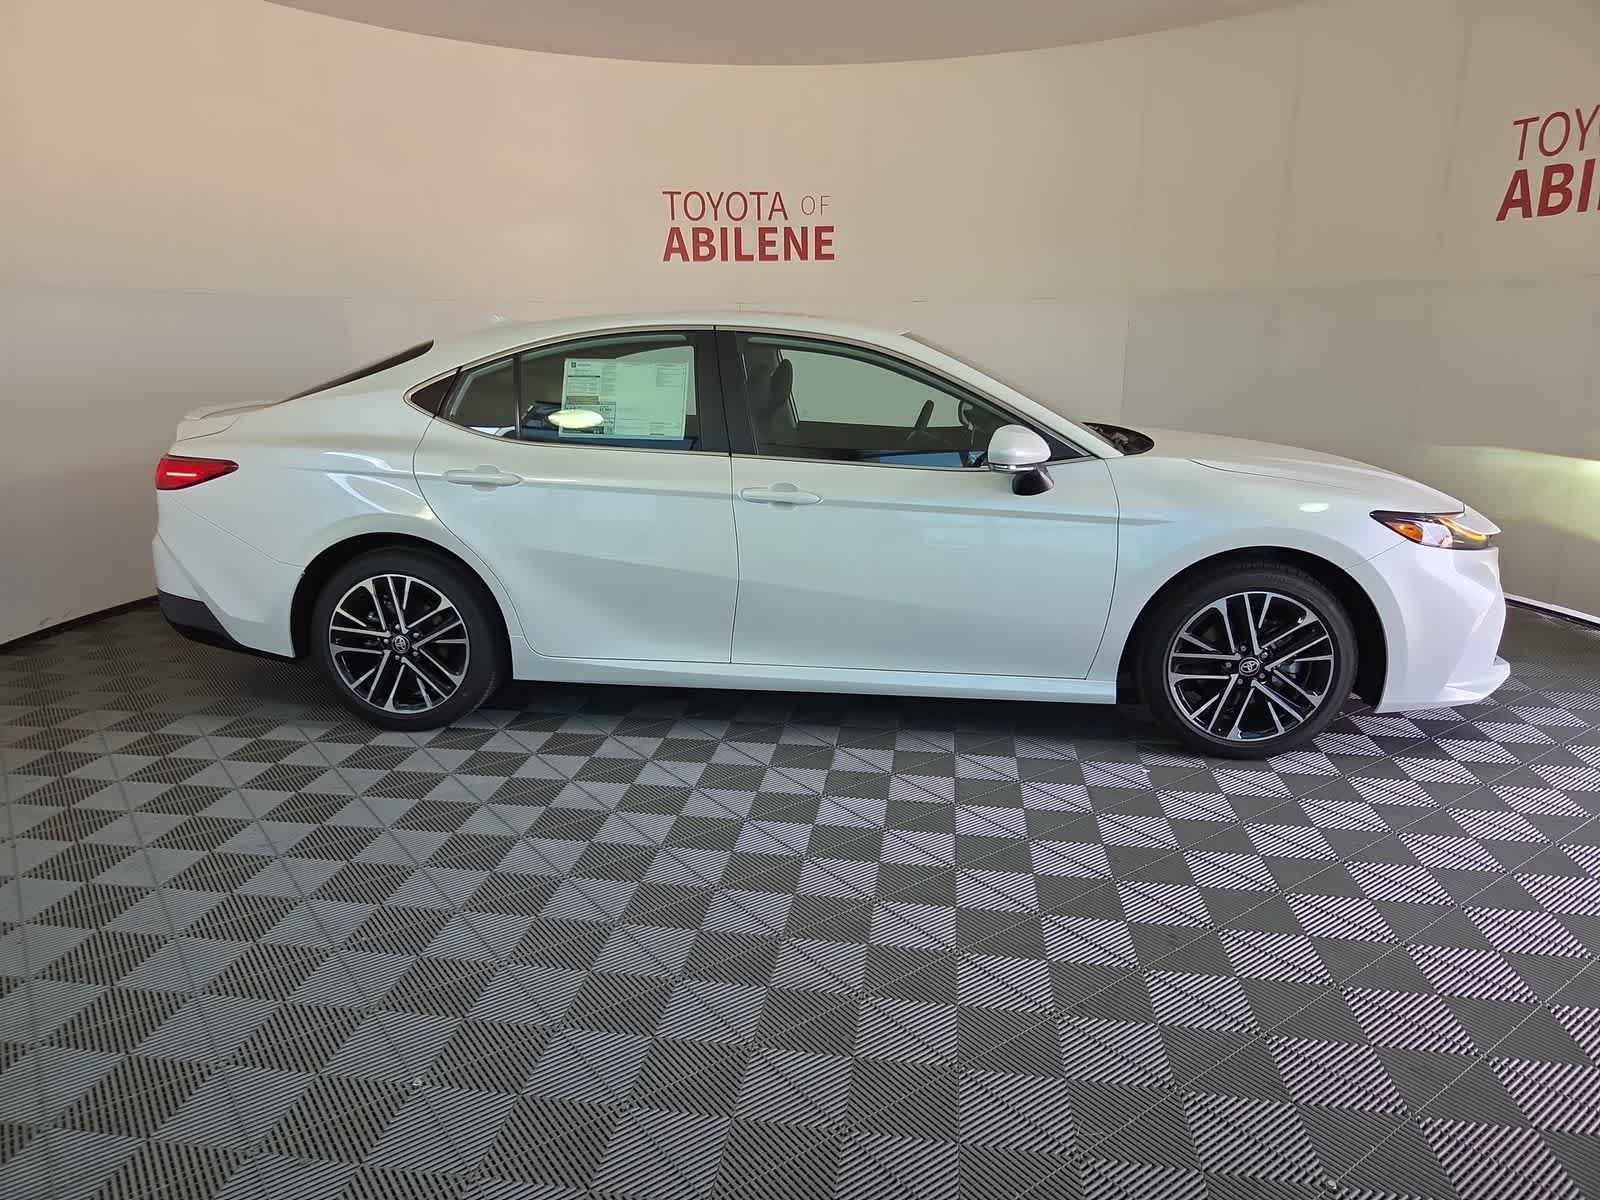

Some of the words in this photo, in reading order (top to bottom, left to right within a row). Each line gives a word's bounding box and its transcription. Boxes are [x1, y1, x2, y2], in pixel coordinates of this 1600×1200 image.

[1513, 104, 1600, 161] TOY
[662, 191, 788, 221] TOYOTA
[801, 195, 831, 216] OF
[1496, 158, 1600, 221] ABI
[662, 226, 835, 262] ABILENE
